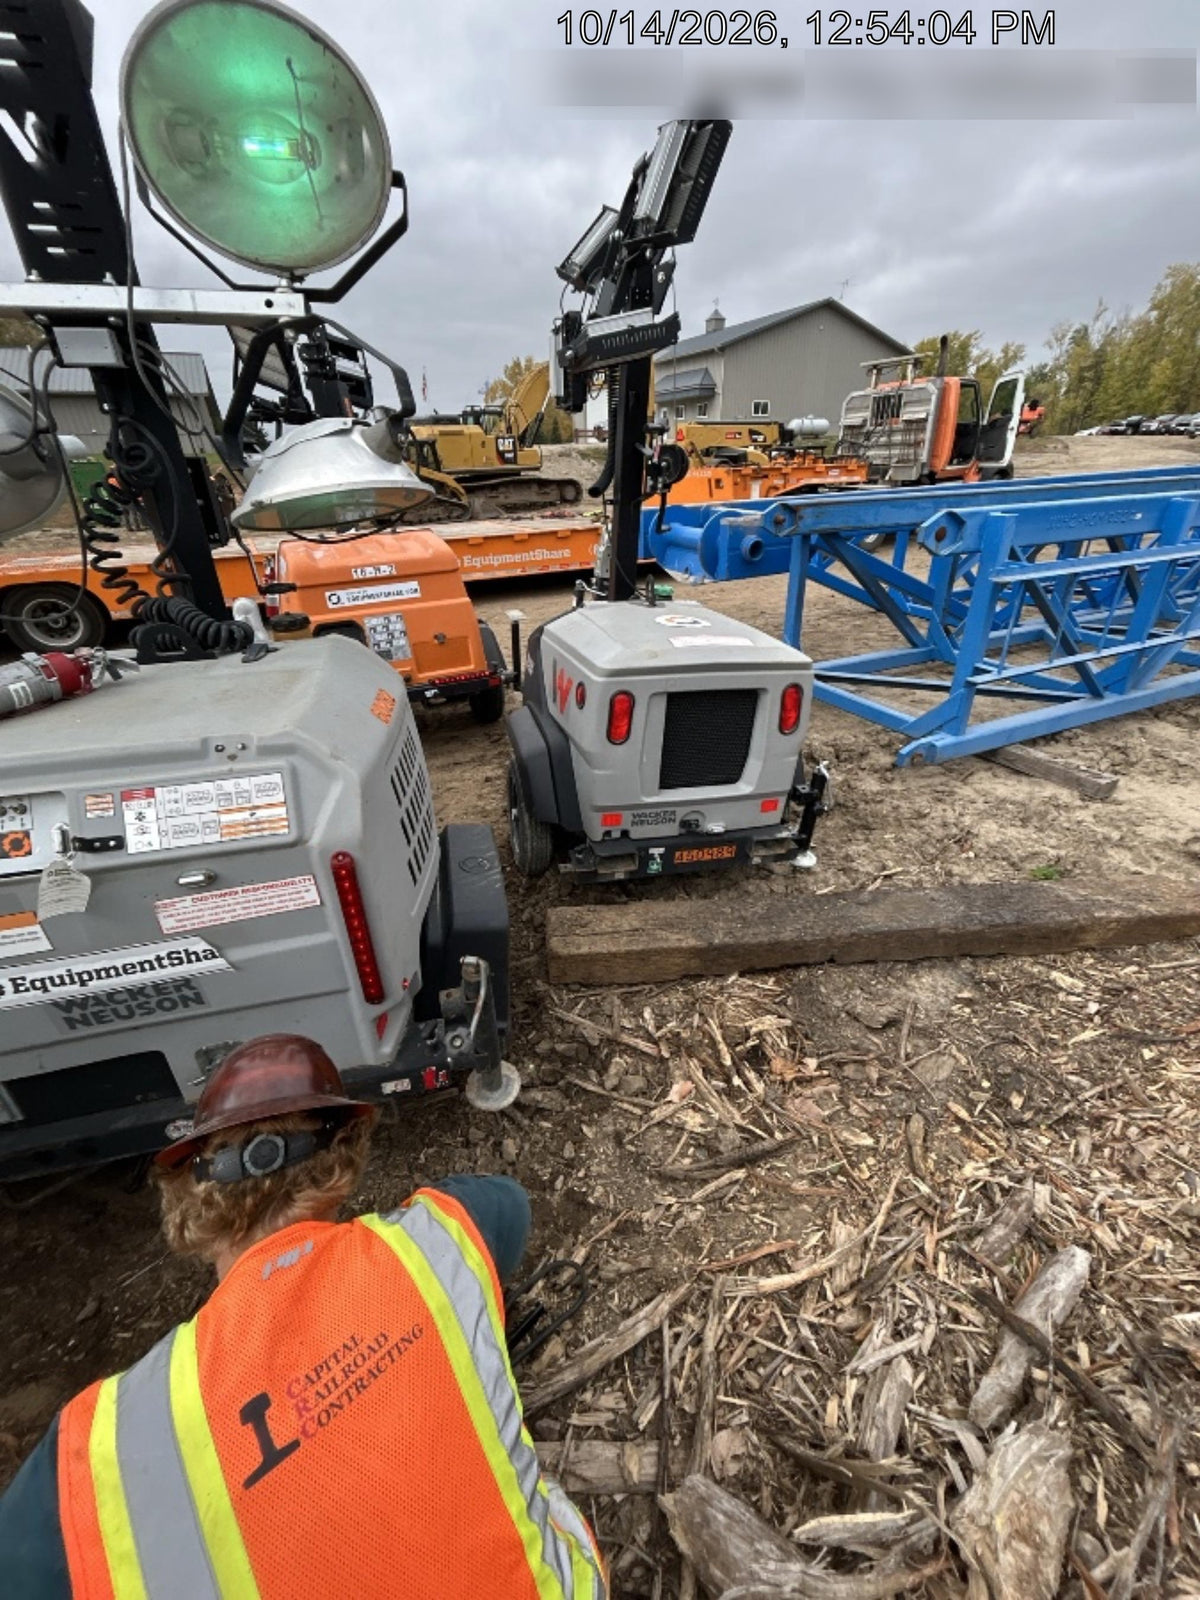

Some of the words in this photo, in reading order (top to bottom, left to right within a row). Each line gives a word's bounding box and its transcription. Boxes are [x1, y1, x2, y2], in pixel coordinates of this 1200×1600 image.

[462, 548, 572, 568] EquipmentShare
[630, 816, 677, 828] NEUSON
[631, 810, 677, 820] WACKER
[63, 991, 206, 1030] NEUSON
[286, 1332, 365, 1400] CAPITAL
[294, 1331, 390, 1421] RAILROAD
[301, 1323, 425, 1440] CONTRACTING
